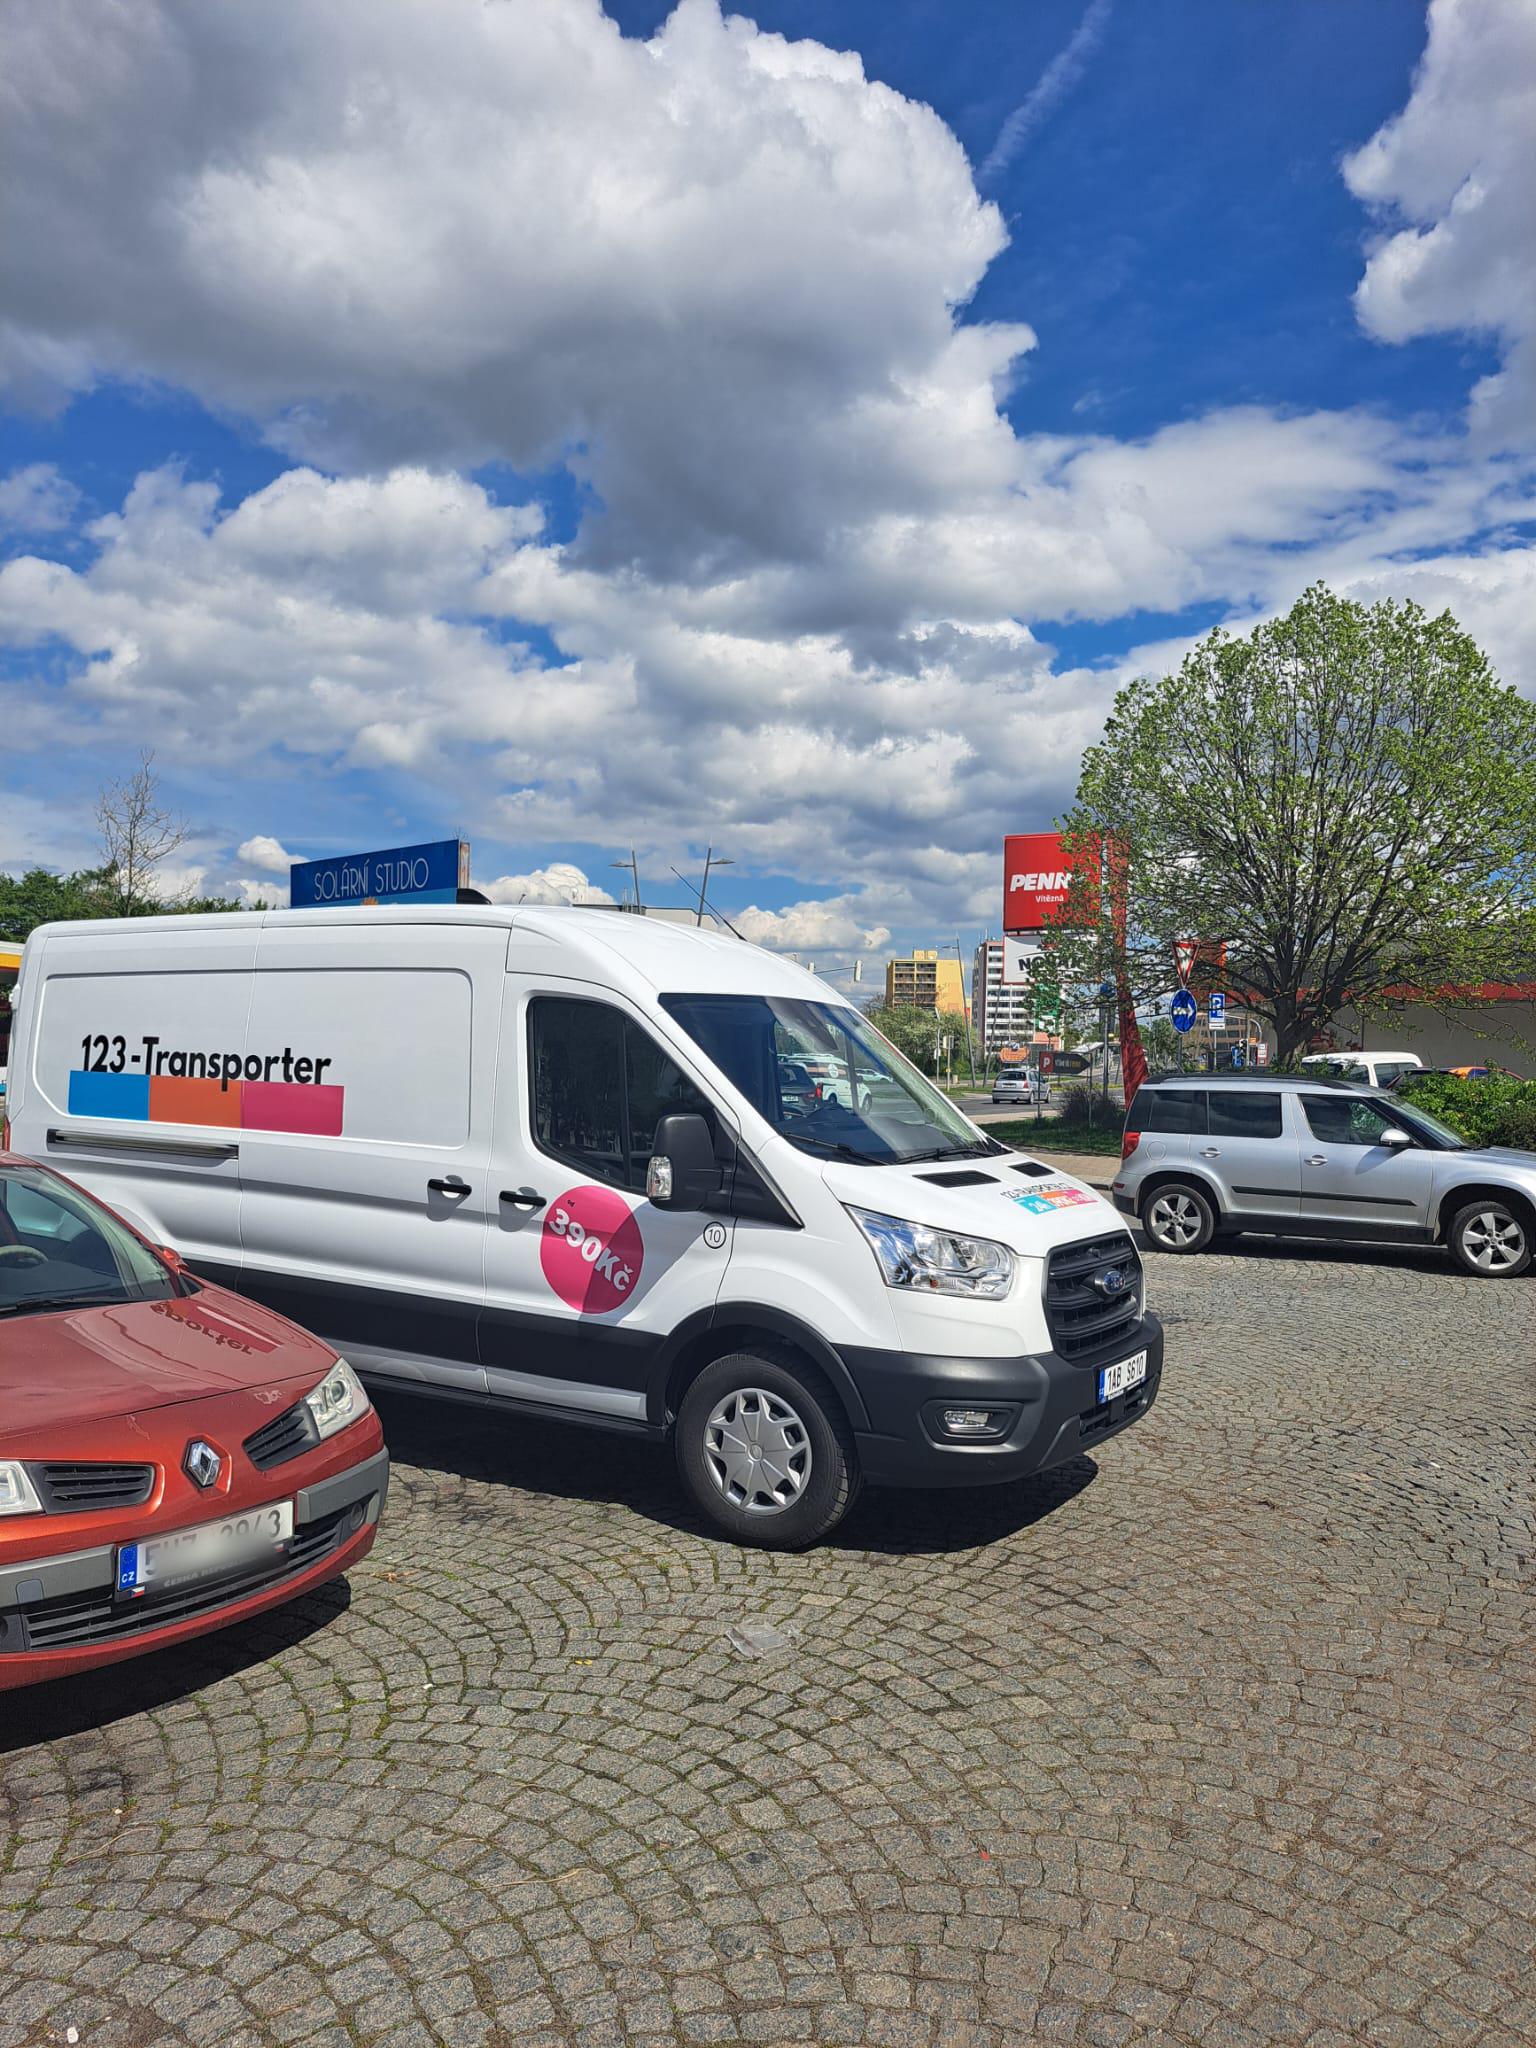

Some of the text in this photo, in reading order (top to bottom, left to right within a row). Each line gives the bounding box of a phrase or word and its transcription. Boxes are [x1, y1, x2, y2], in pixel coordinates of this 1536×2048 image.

[314, 858, 429, 901] SOLÁRNÍ STUDIO
[1010, 872, 1090, 892] PENN
[708, 1228, 721, 1244] 10
[121, 1570, 136, 1584] CZ
